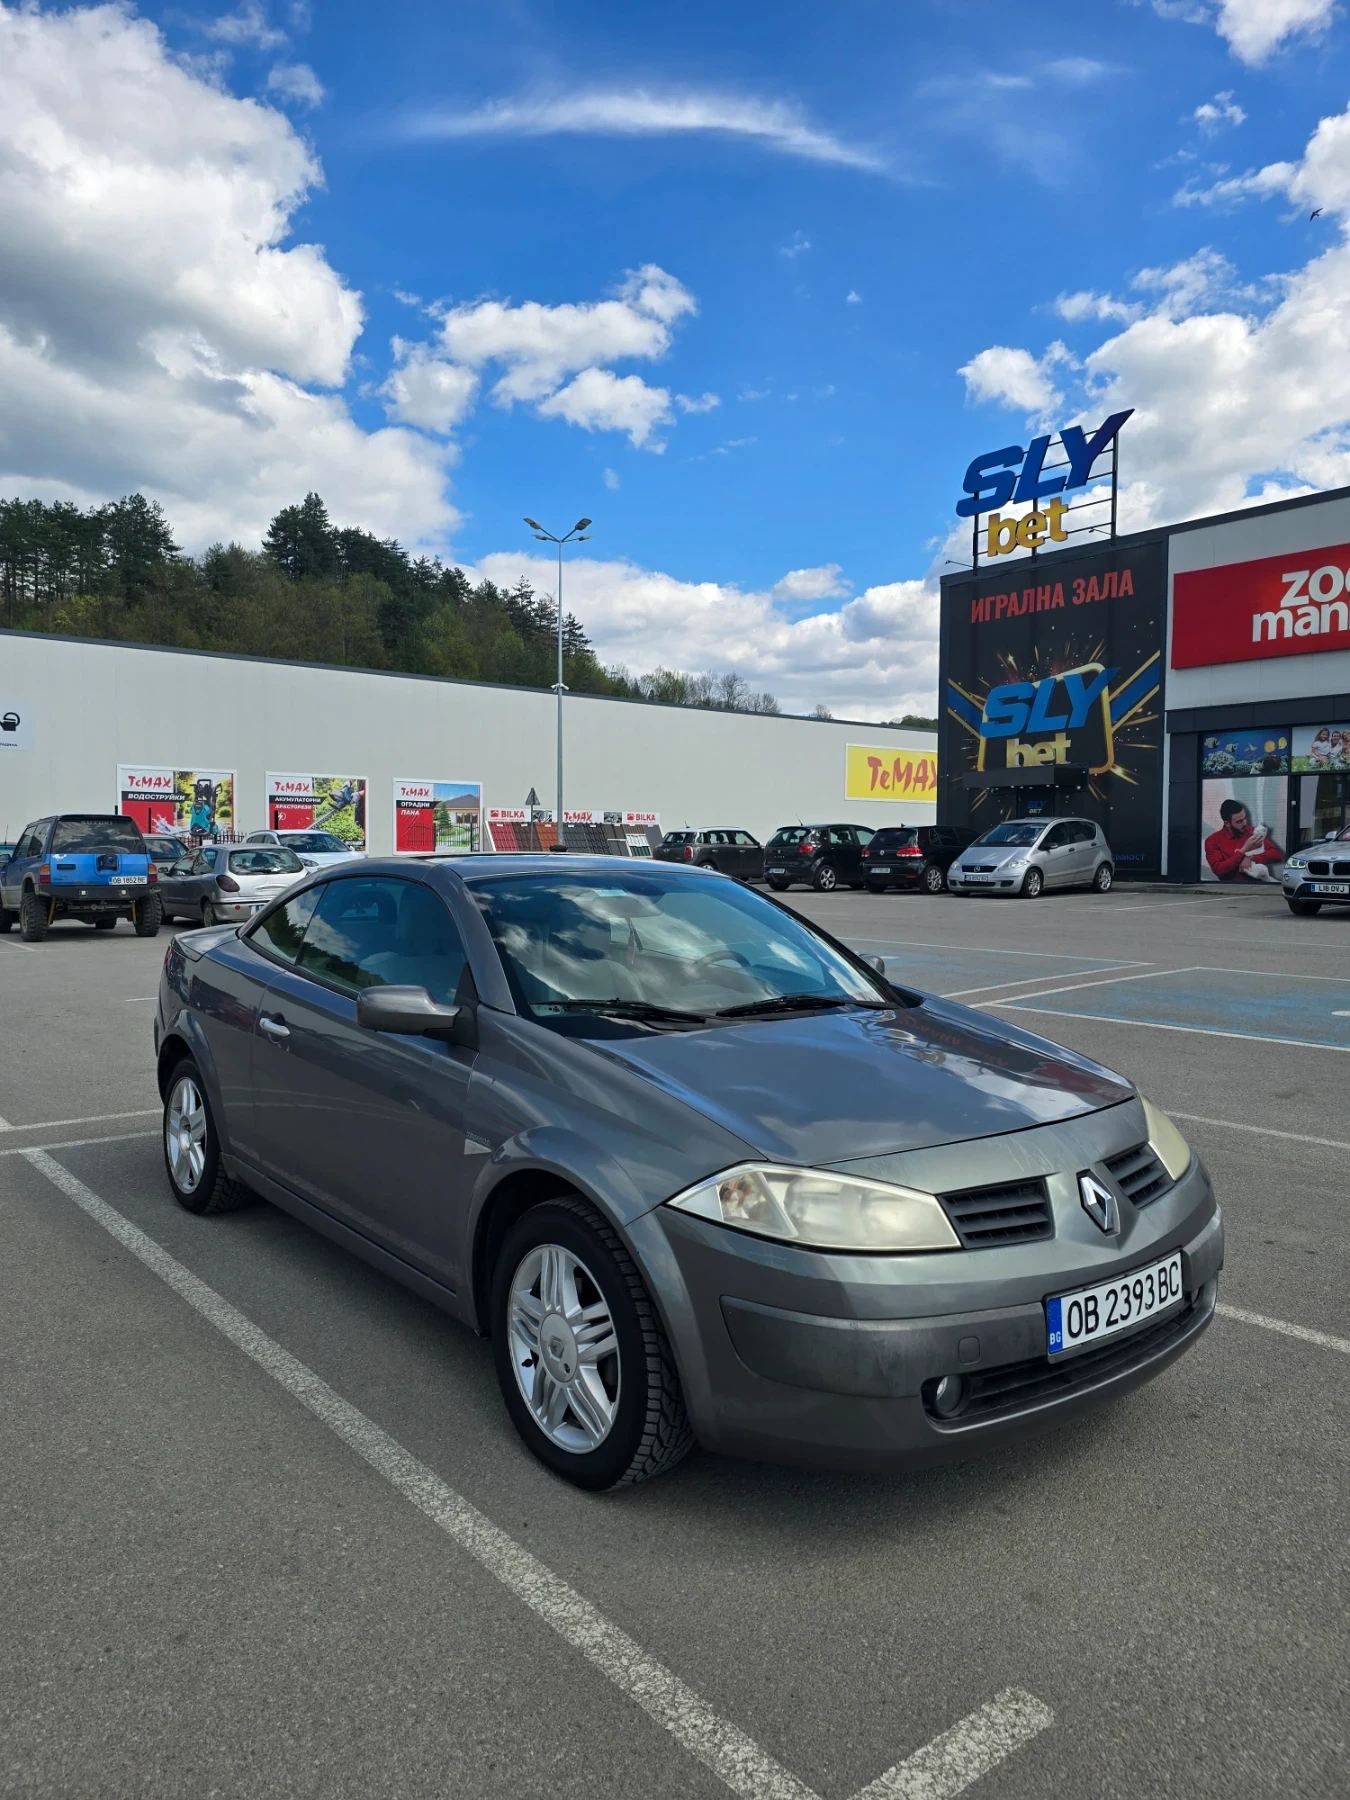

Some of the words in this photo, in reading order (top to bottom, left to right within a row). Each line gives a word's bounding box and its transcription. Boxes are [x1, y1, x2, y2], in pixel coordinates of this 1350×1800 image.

[956, 408, 1135, 517] SLY
[987, 497, 1069, 557] bet
[971, 582, 1065, 623] ИГРАЛНА
[1072, 569, 1135, 605] ЗАЛА
[1280, 565, 1350, 608] zo
[1252, 601, 1350, 643] man
[979, 667, 1121, 739] SLY
[1006, 732, 1072, 769] bet
[127, 775, 172, 789] TeMAX
[274, 781, 310, 792] TeMAX
[401, 787, 430, 797] TeMAX
[127, 793, 186, 801] ВОДОСТРУЙКИ
[501, 810, 525, 818] BILKA
[563, 811, 593, 822] TeMAX
[635, 813, 656, 821] BILKA
[1067, 1294, 1100, 1339] OB
[1049, 1331, 1062, 1345] BG
